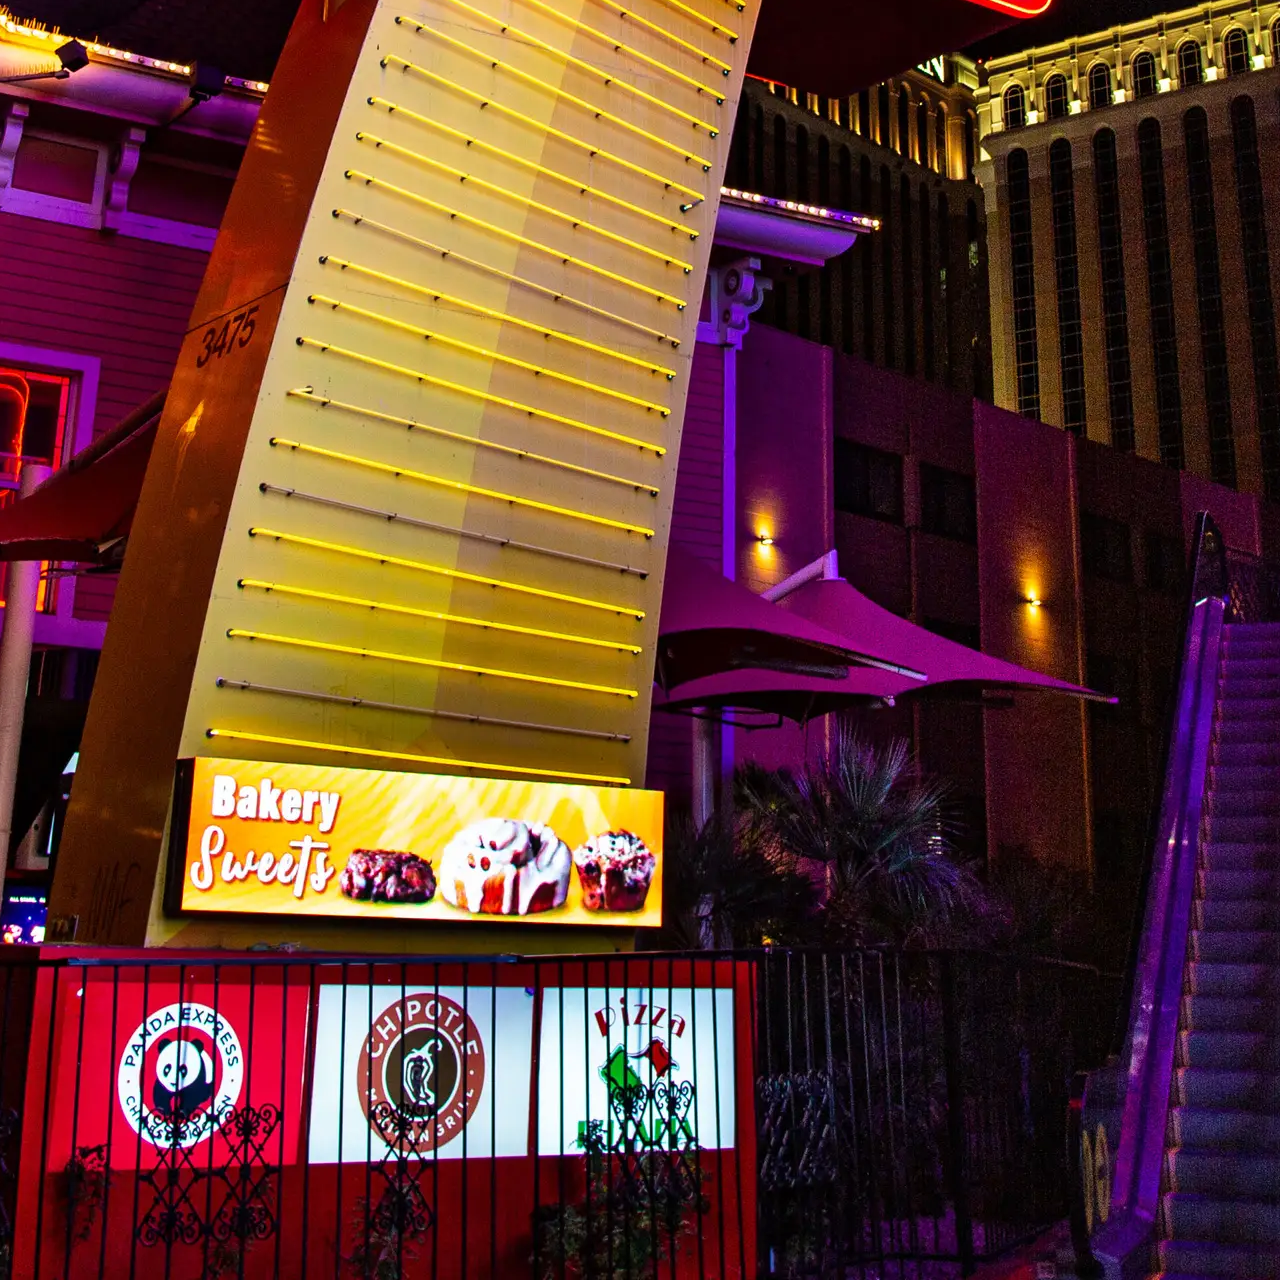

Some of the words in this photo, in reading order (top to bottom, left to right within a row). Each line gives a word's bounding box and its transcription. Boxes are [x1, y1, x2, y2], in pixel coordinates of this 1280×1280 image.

[197, 307, 259, 368] 3475
[211, 774, 340, 833] Bakery
[189, 826, 335, 899] Sweets
[124, 1011, 175, 1067] PANDA
[181, 1007, 239, 1067] EXPRESS
[366, 1000, 480, 1058] CHIPOTLE
